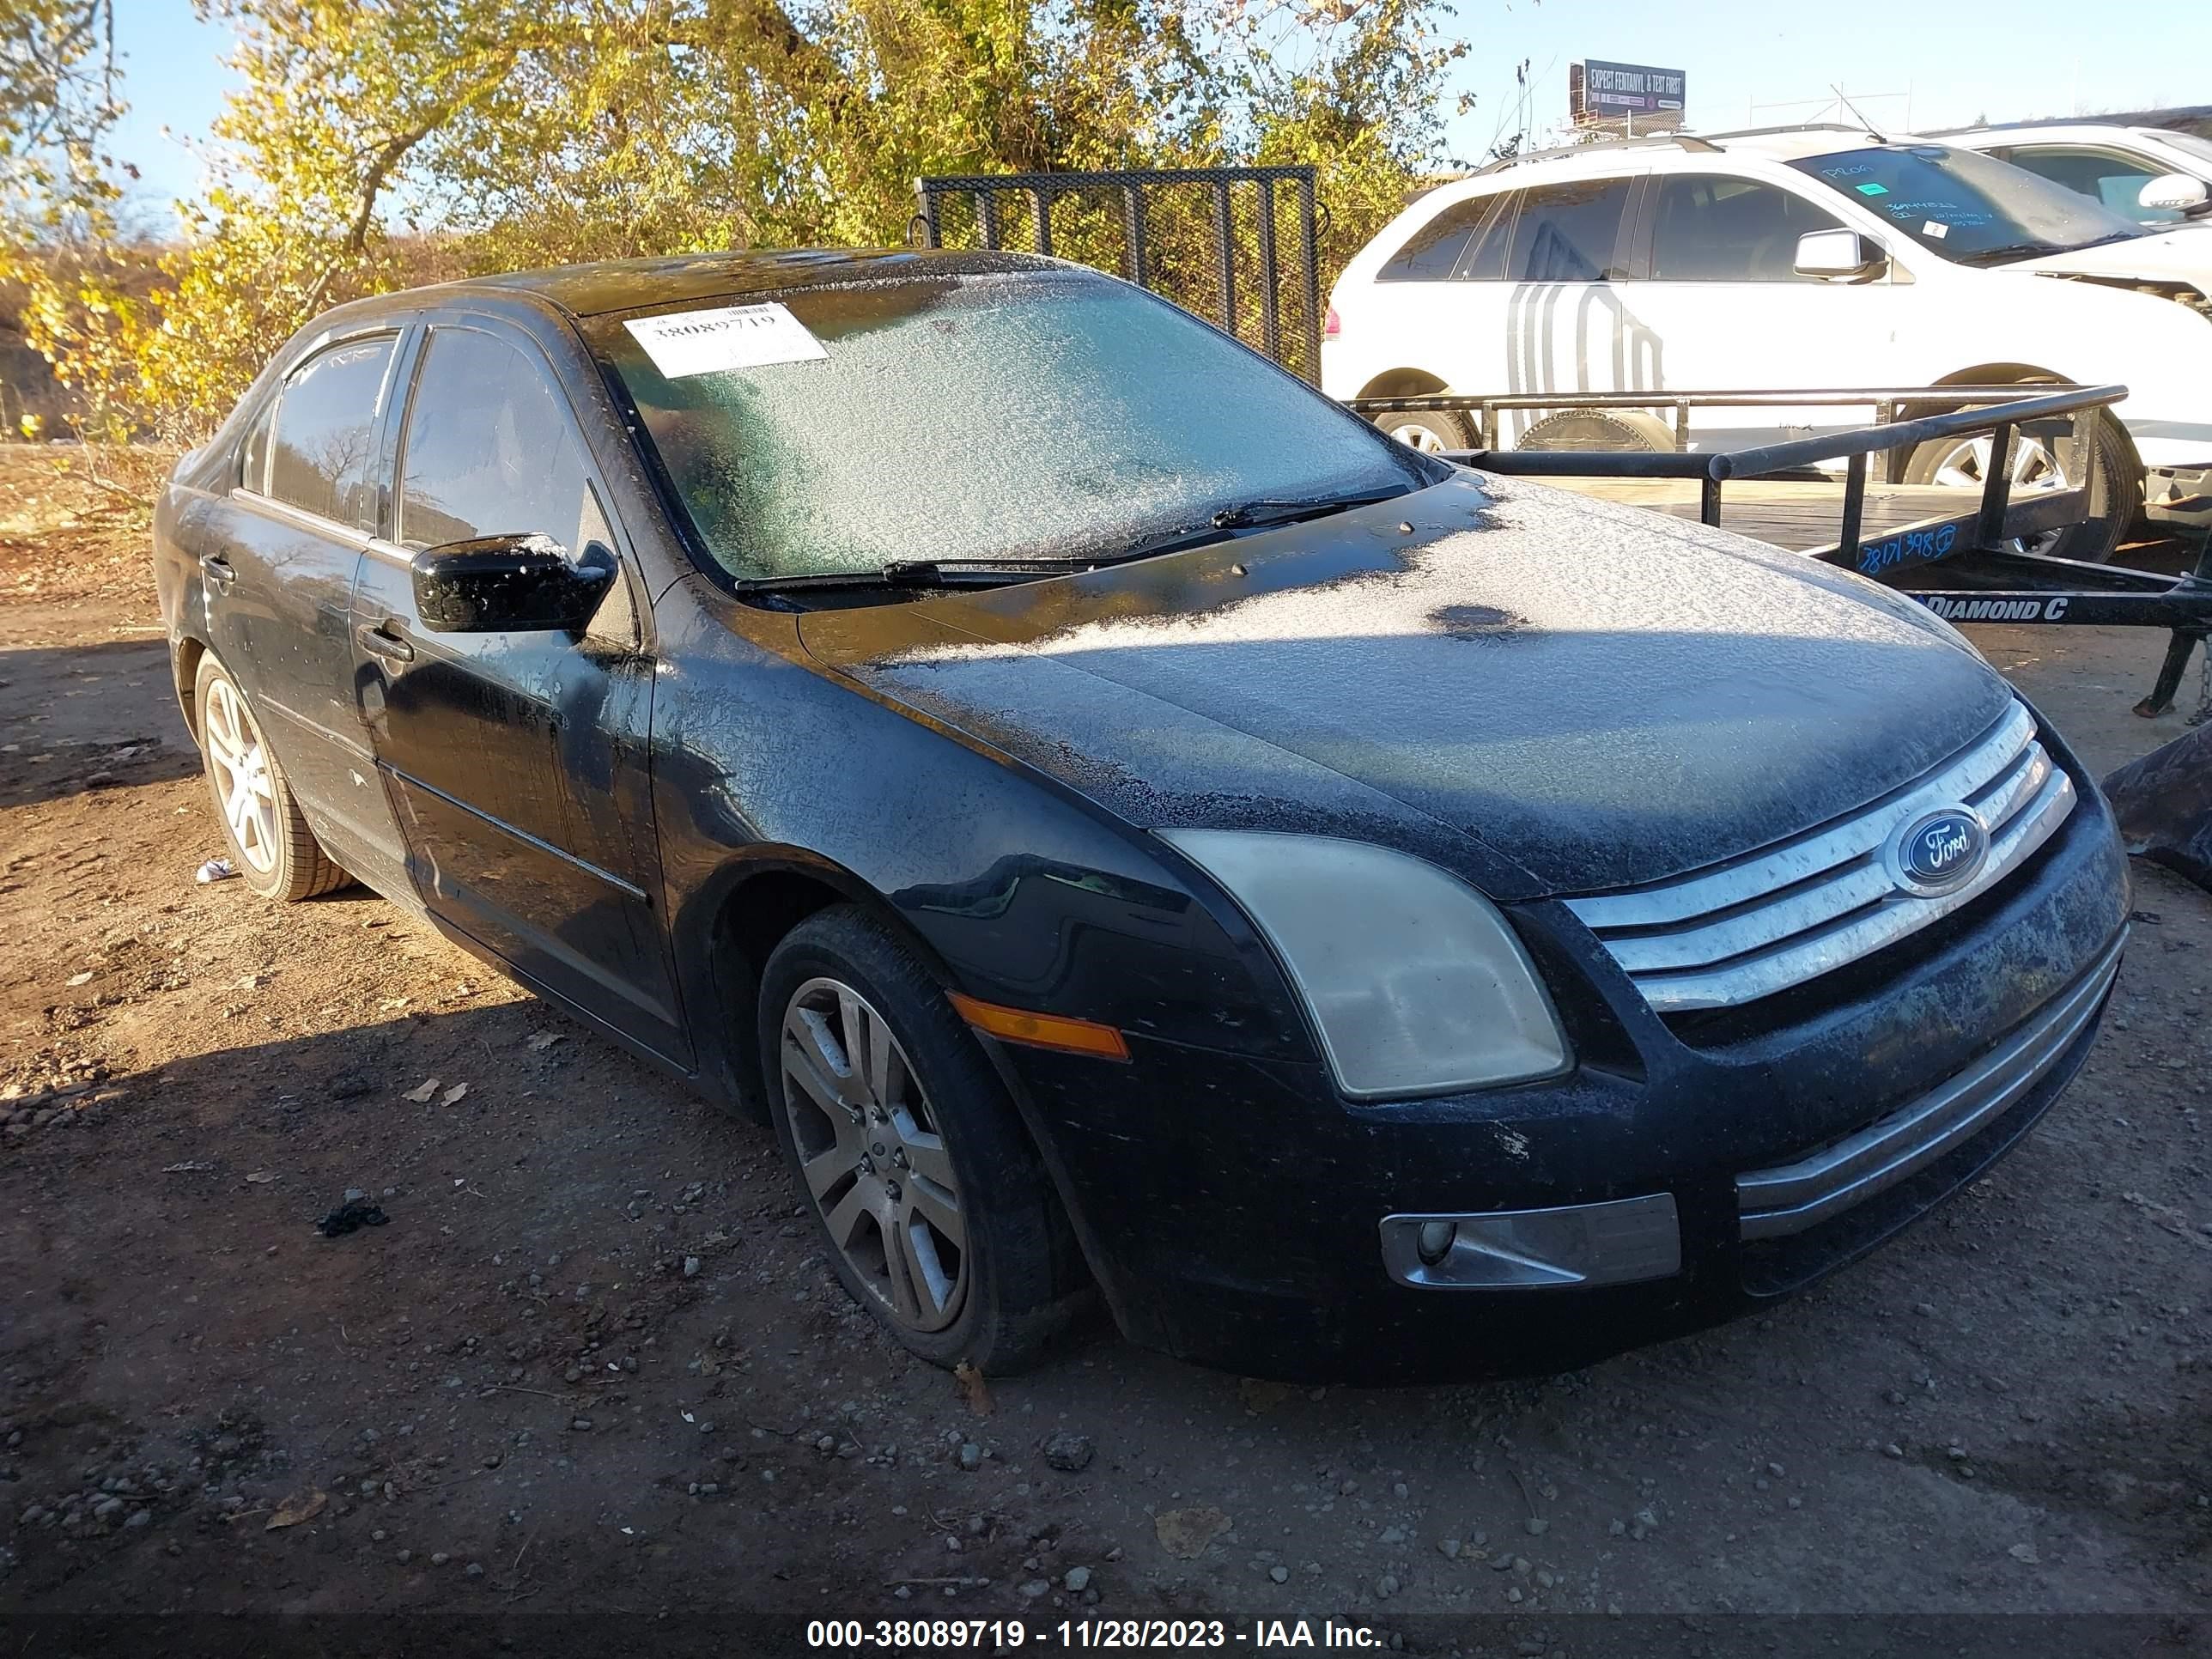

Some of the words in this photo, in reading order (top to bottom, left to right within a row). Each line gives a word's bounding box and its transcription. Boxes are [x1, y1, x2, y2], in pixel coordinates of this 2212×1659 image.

[1591, 69, 1614, 90] EXPECT
[1652, 75, 1666, 93] TEST
[1666, 76, 1681, 94] FIRST
[1928, 597, 2041, 619] DIAMOND
[2044, 597, 2069, 620] C
[1925, 824, 1971, 868] Ford
